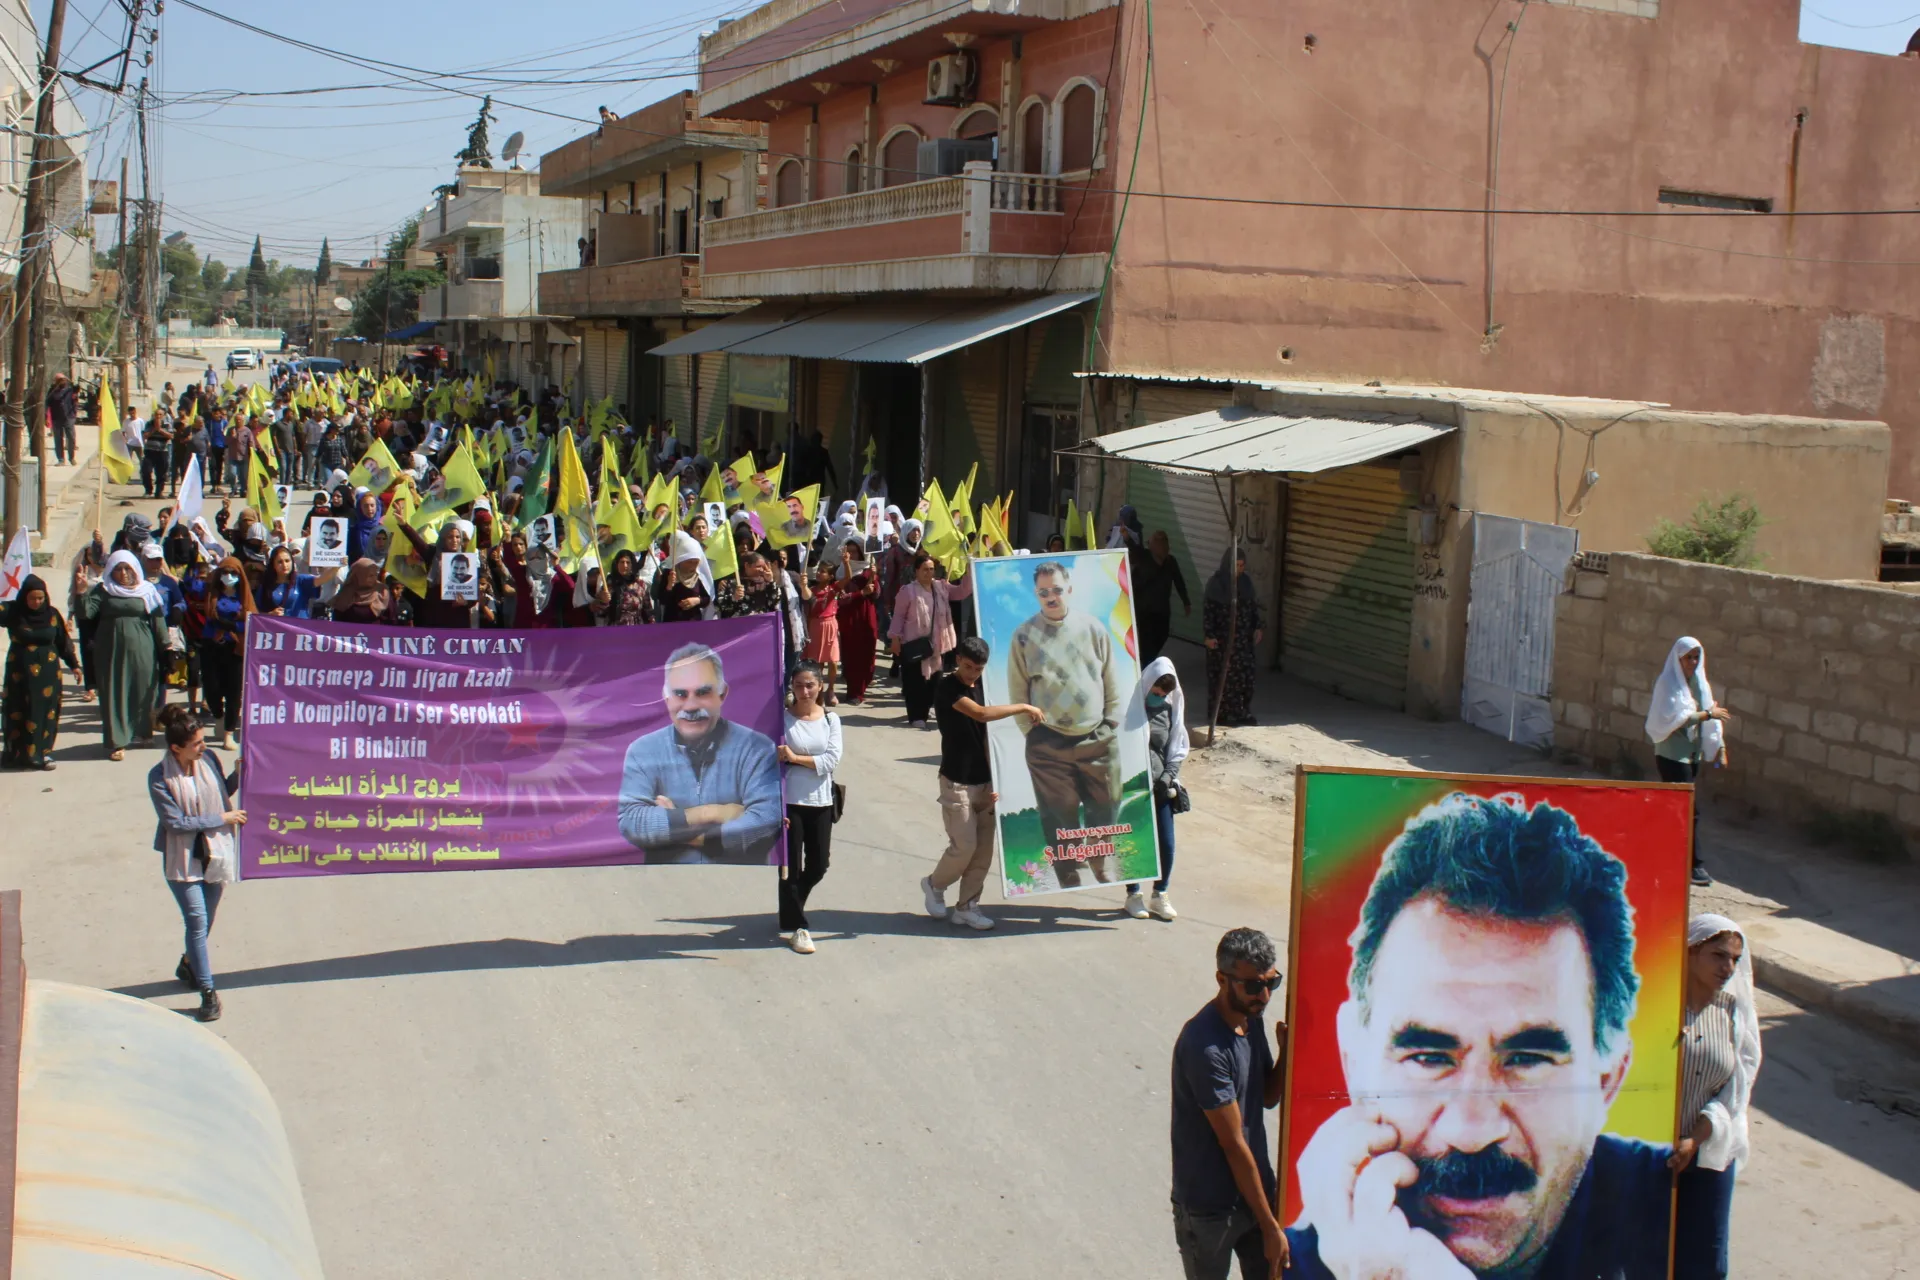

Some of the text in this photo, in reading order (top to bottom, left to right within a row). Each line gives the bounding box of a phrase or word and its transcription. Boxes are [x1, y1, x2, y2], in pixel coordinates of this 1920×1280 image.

[254, 631, 525, 655] BI RUHÊ JINÊ CIWAN
[258, 664, 513, 692] Bi Durşmeya Jin Jiyan Azadî
[249, 700, 522, 727] Emê Kompiloya Li Ser Serokatî
[330, 736, 427, 759] Bi Binbixin
[288, 768, 460, 801] بروح المرأة الشابة
[268, 804, 484, 835] بشعار المرأة حياة حرة
[1056, 823, 1132, 840] Nexweşxana
[258, 837, 500, 866] سنحطم الأنقلاب على القائد
